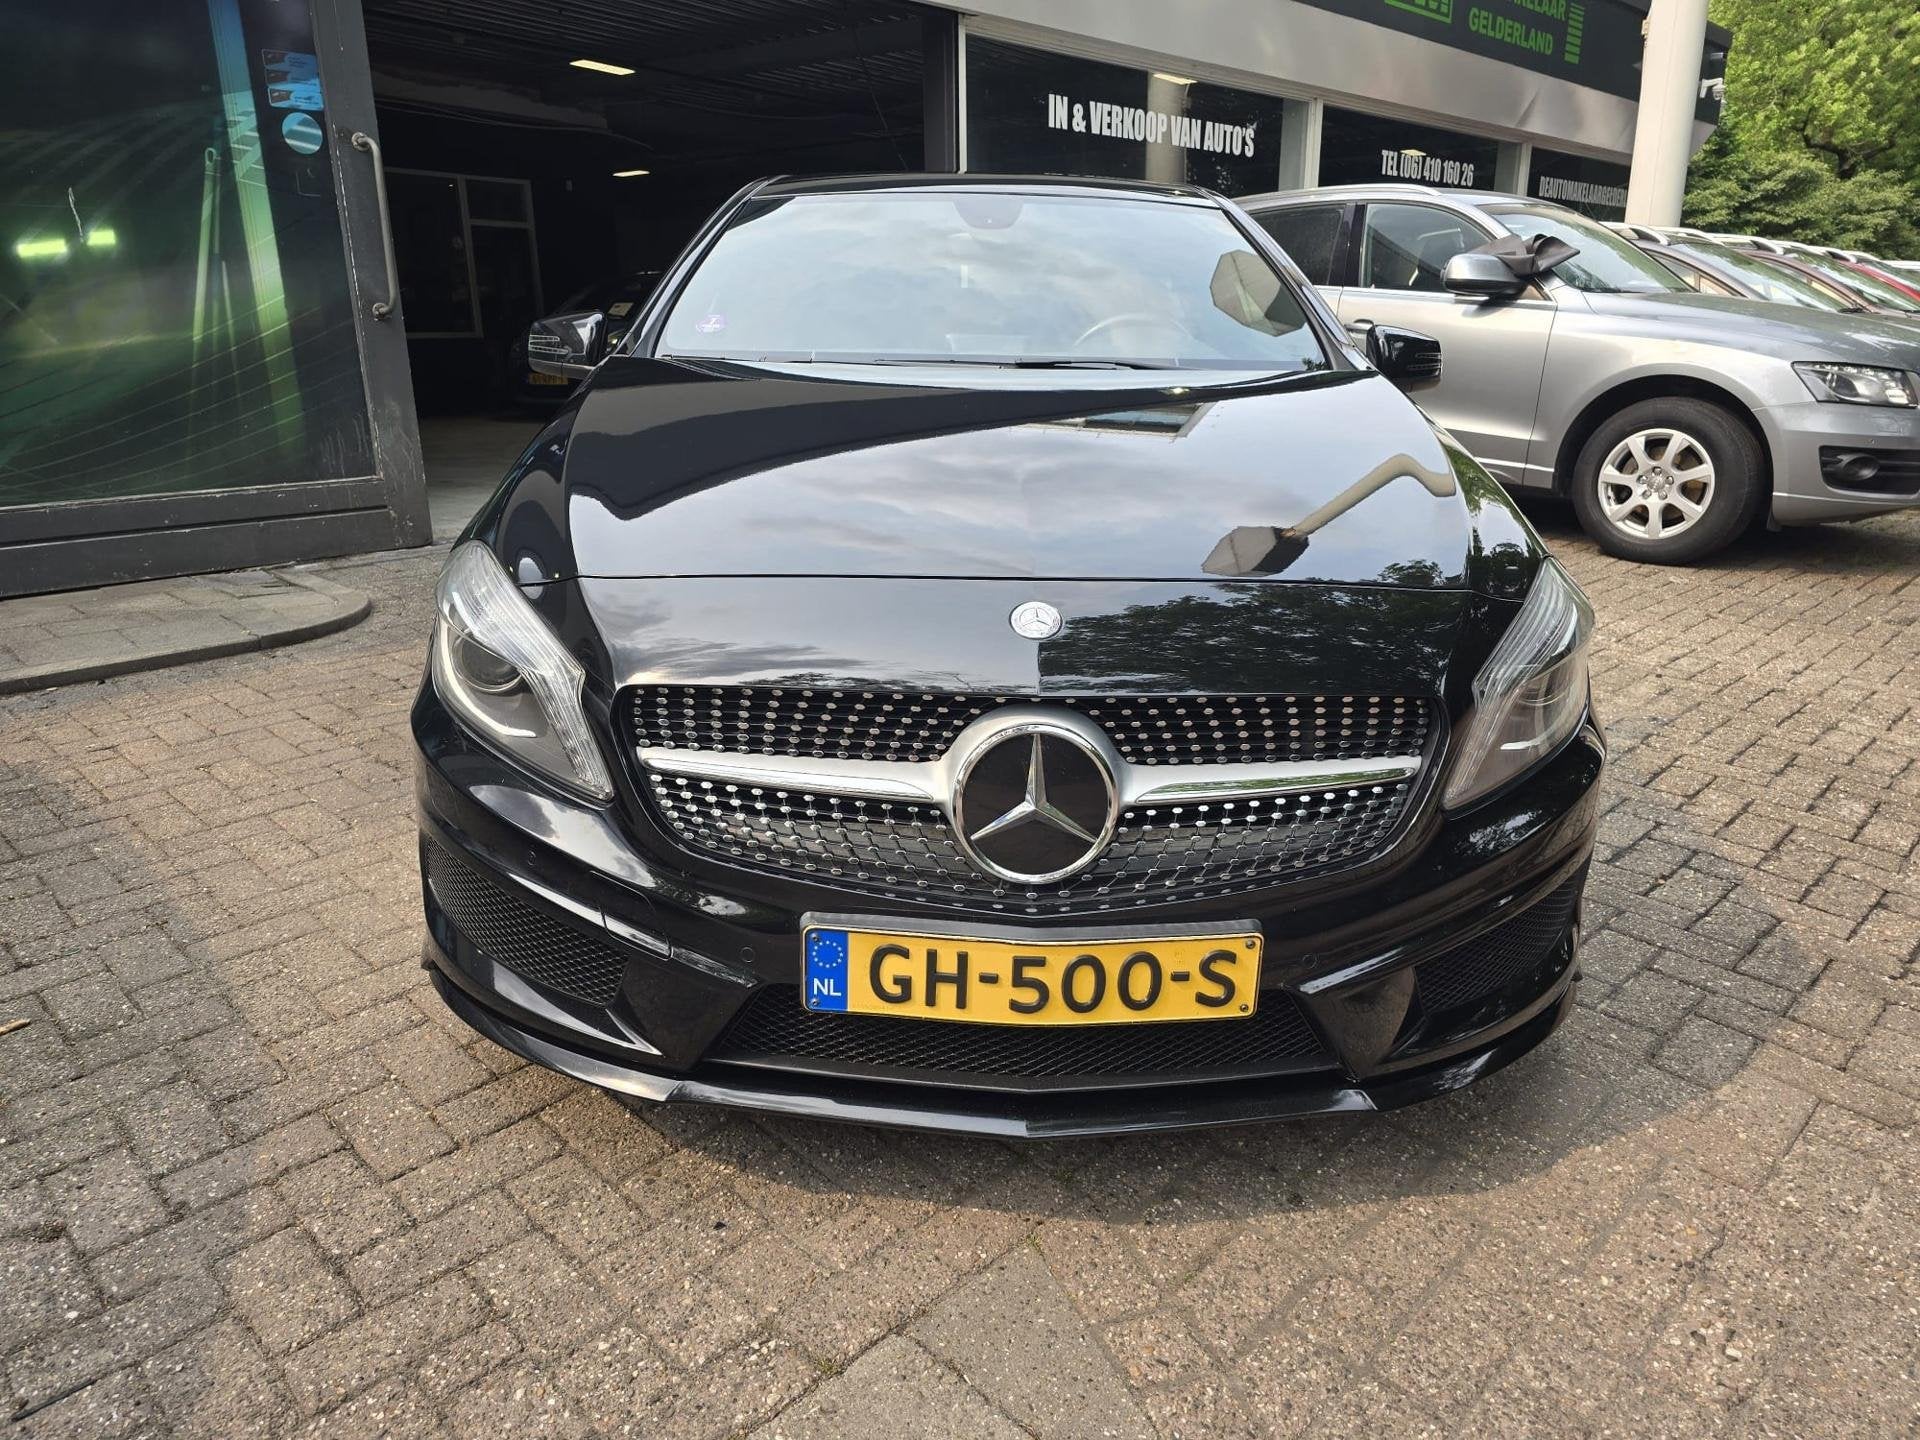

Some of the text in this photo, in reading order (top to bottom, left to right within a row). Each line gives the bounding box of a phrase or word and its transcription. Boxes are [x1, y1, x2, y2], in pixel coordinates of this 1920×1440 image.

[1468, 7, 1553, 56] GELDERLAND
[1048, 93, 1255, 158] IN & VERKOOP VAN AUTO'S
[1381, 149, 1474, 187] TEL (06) 410 160 26
[813, 977, 842, 997] NL
[868, 943, 1238, 1014] GH-500-S
